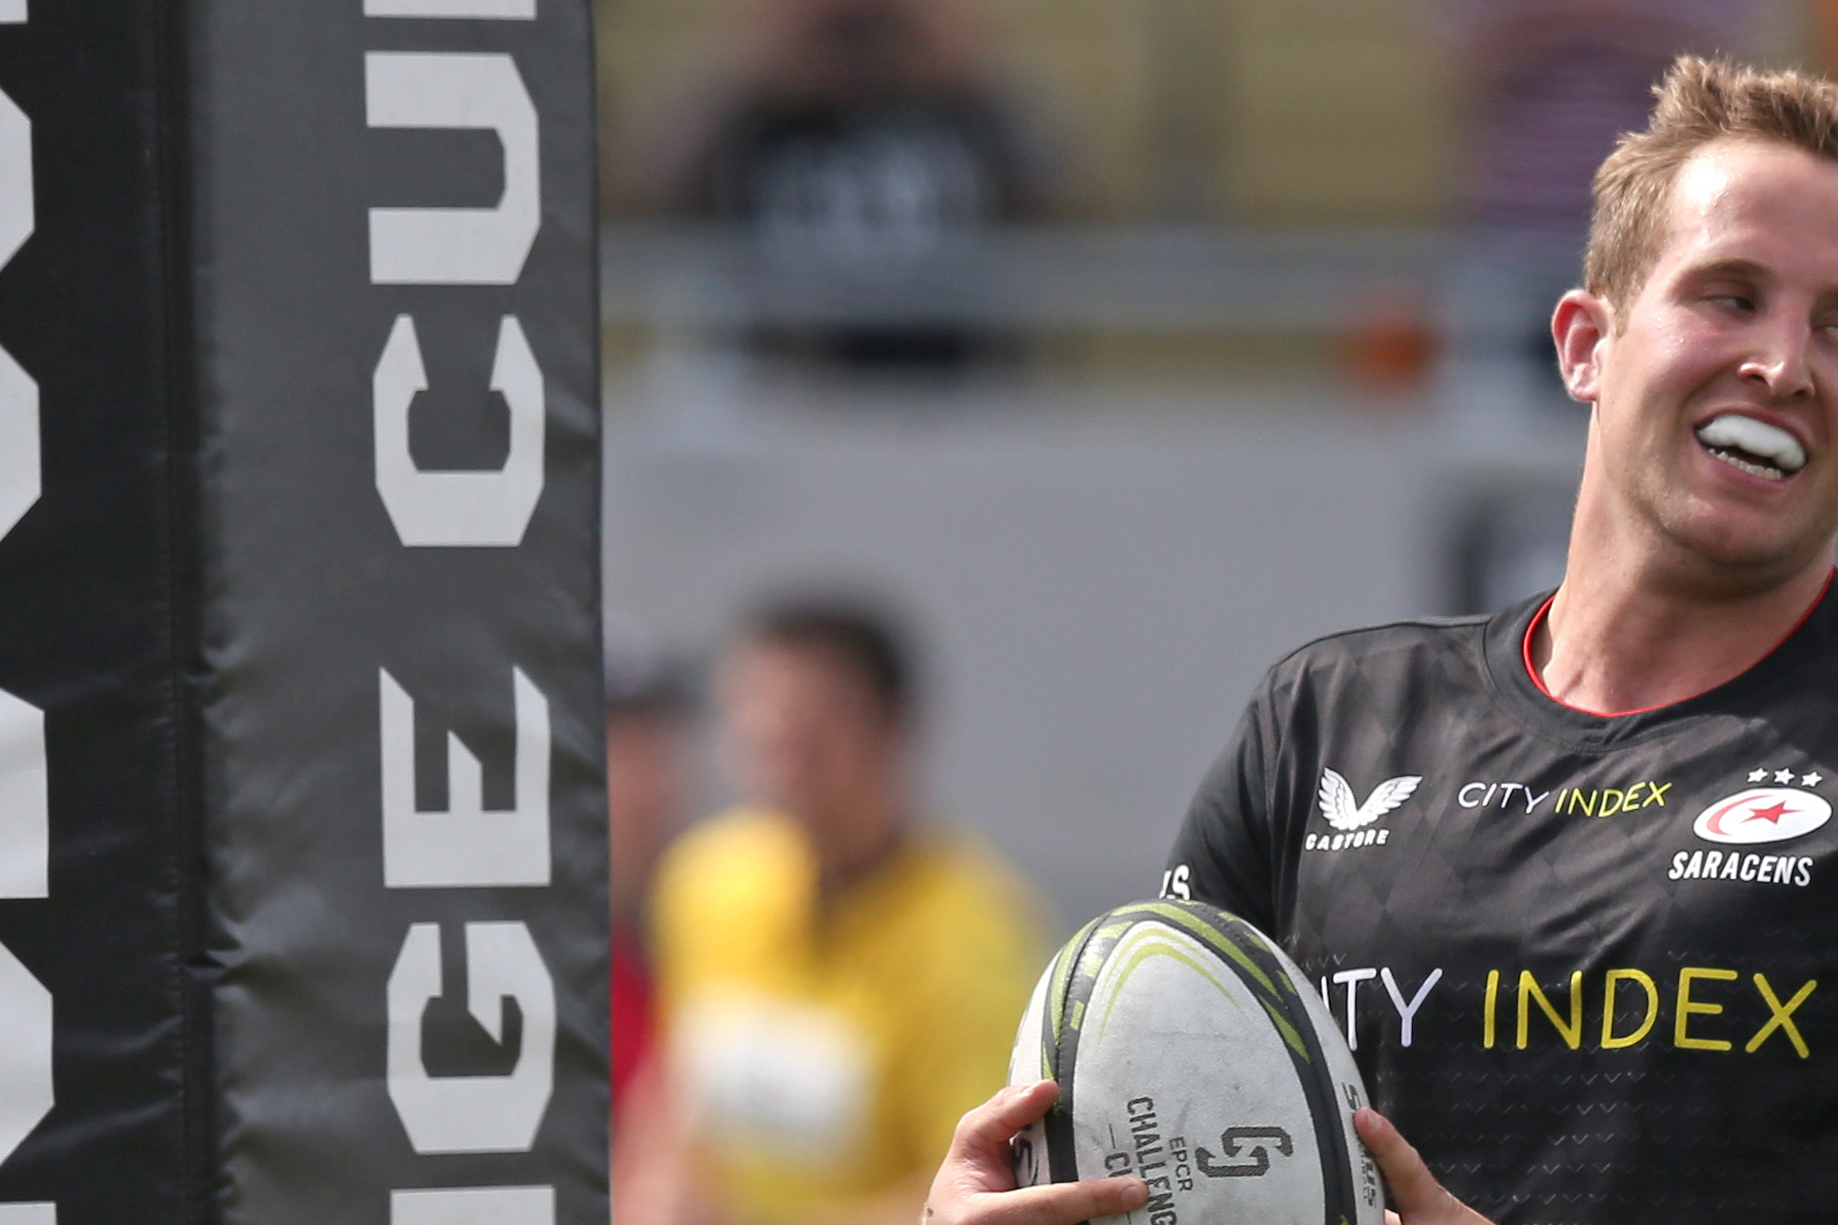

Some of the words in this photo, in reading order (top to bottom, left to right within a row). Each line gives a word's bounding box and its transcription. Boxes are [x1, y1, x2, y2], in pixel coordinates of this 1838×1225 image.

[362, 0, 546, 547] CU
[1457, 782, 1550, 815] CITY
[1554, 781, 1673, 818] INDEX
[1304, 828, 1391, 852] CASTORE
[1667, 850, 1815, 888] SARACENS
[1483, 966, 1818, 1060] INDEX
[1168, 1136, 1194, 1193] EPCR
